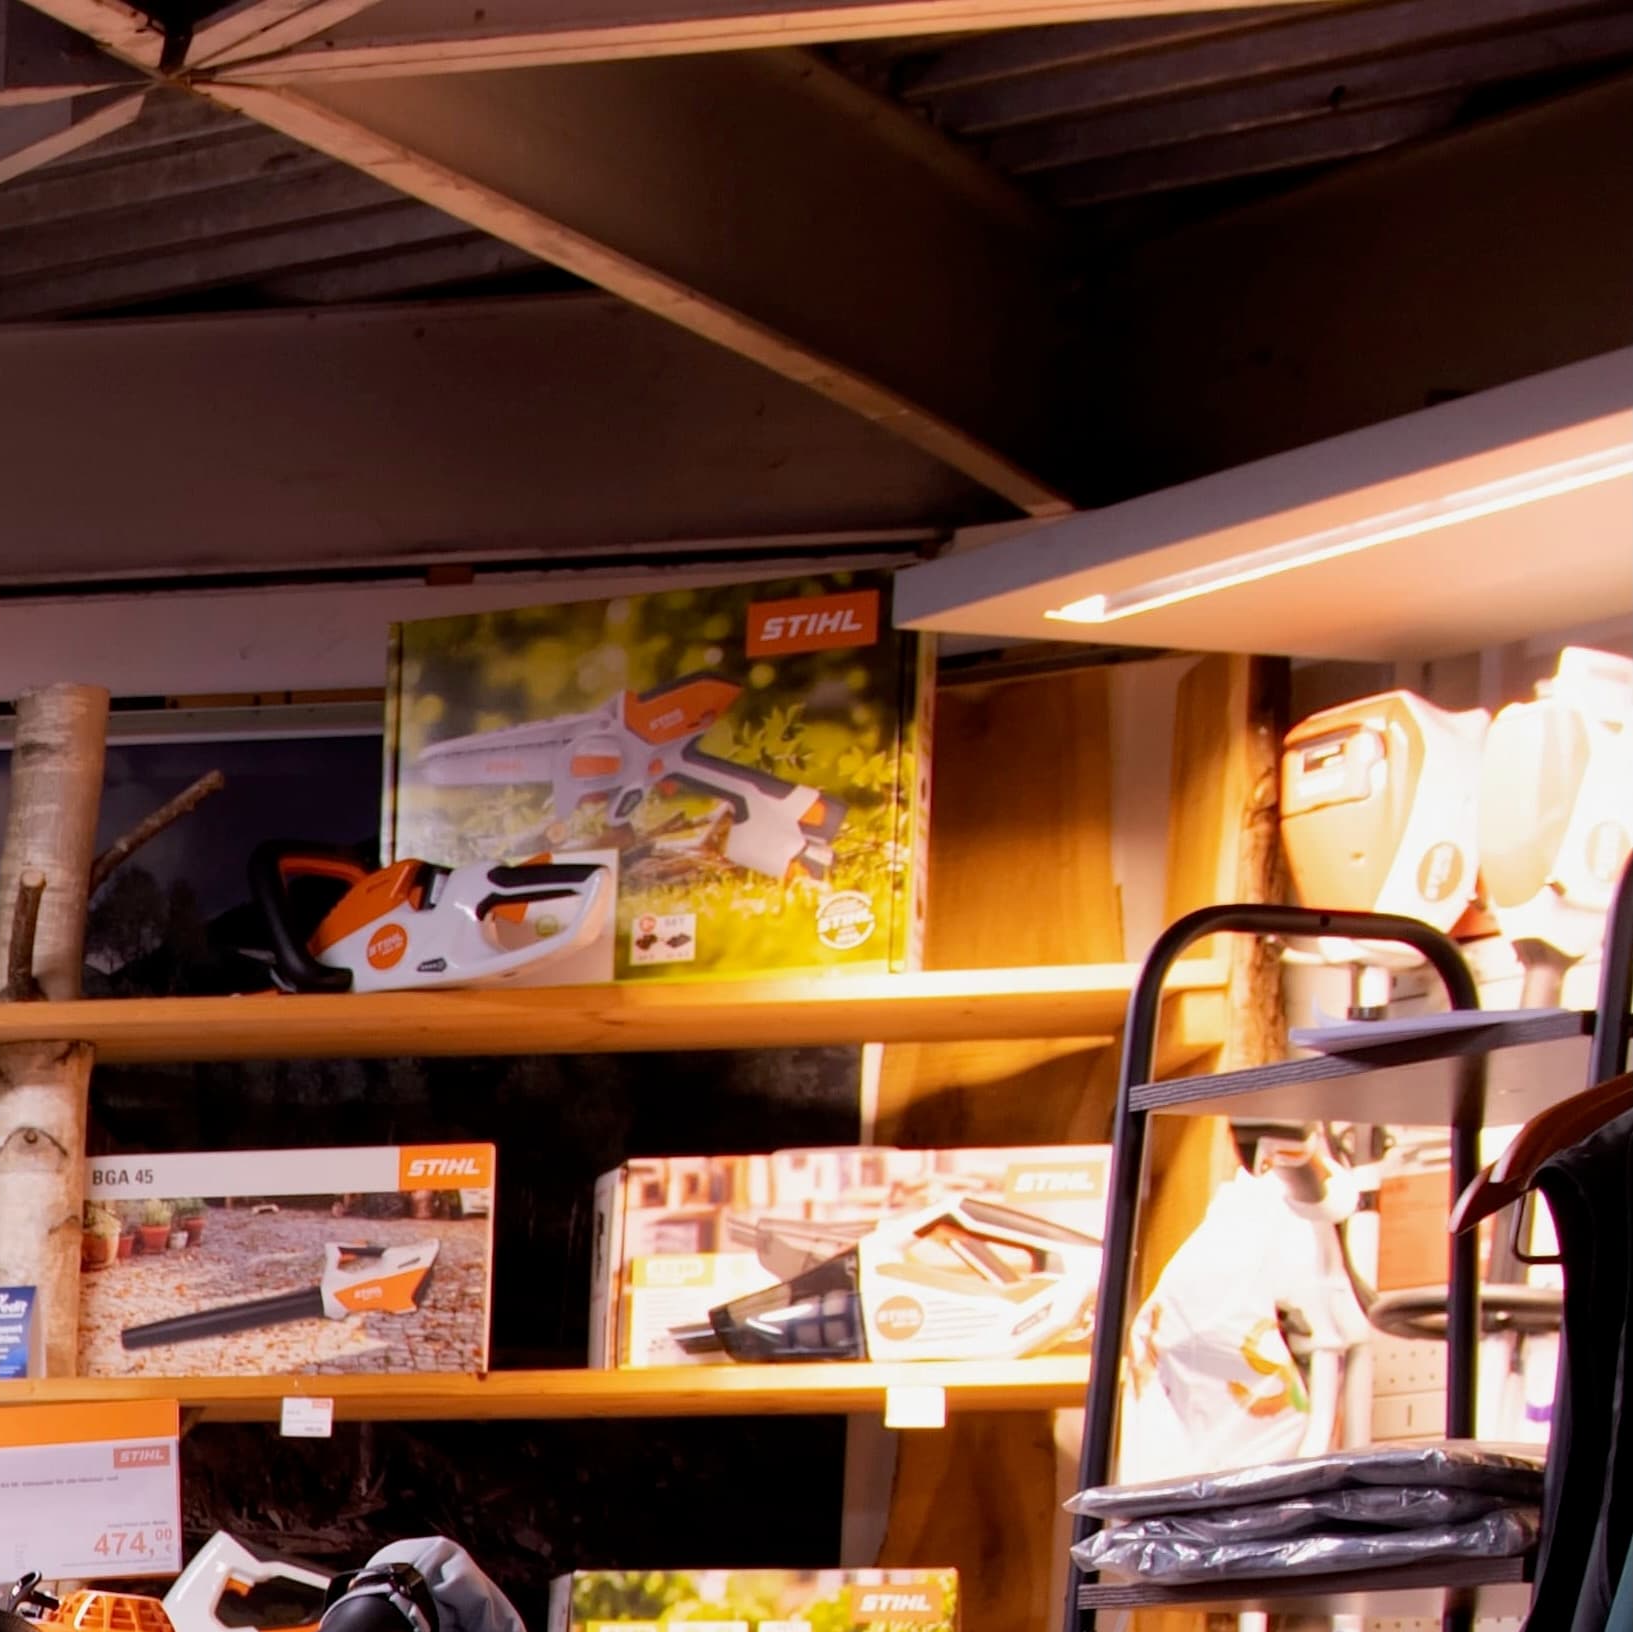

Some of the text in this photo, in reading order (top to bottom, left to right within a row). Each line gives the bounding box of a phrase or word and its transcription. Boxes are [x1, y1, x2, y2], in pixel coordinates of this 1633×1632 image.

[760, 608, 863, 642] STIHL
[407, 1157, 481, 1177] STIHL
[91, 1168, 154, 1186] BGA 45
[1014, 1171, 1095, 1193] STIHL
[120, 1449, 164, 1463] STIHL
[859, 1594, 932, 1613] STIHL
